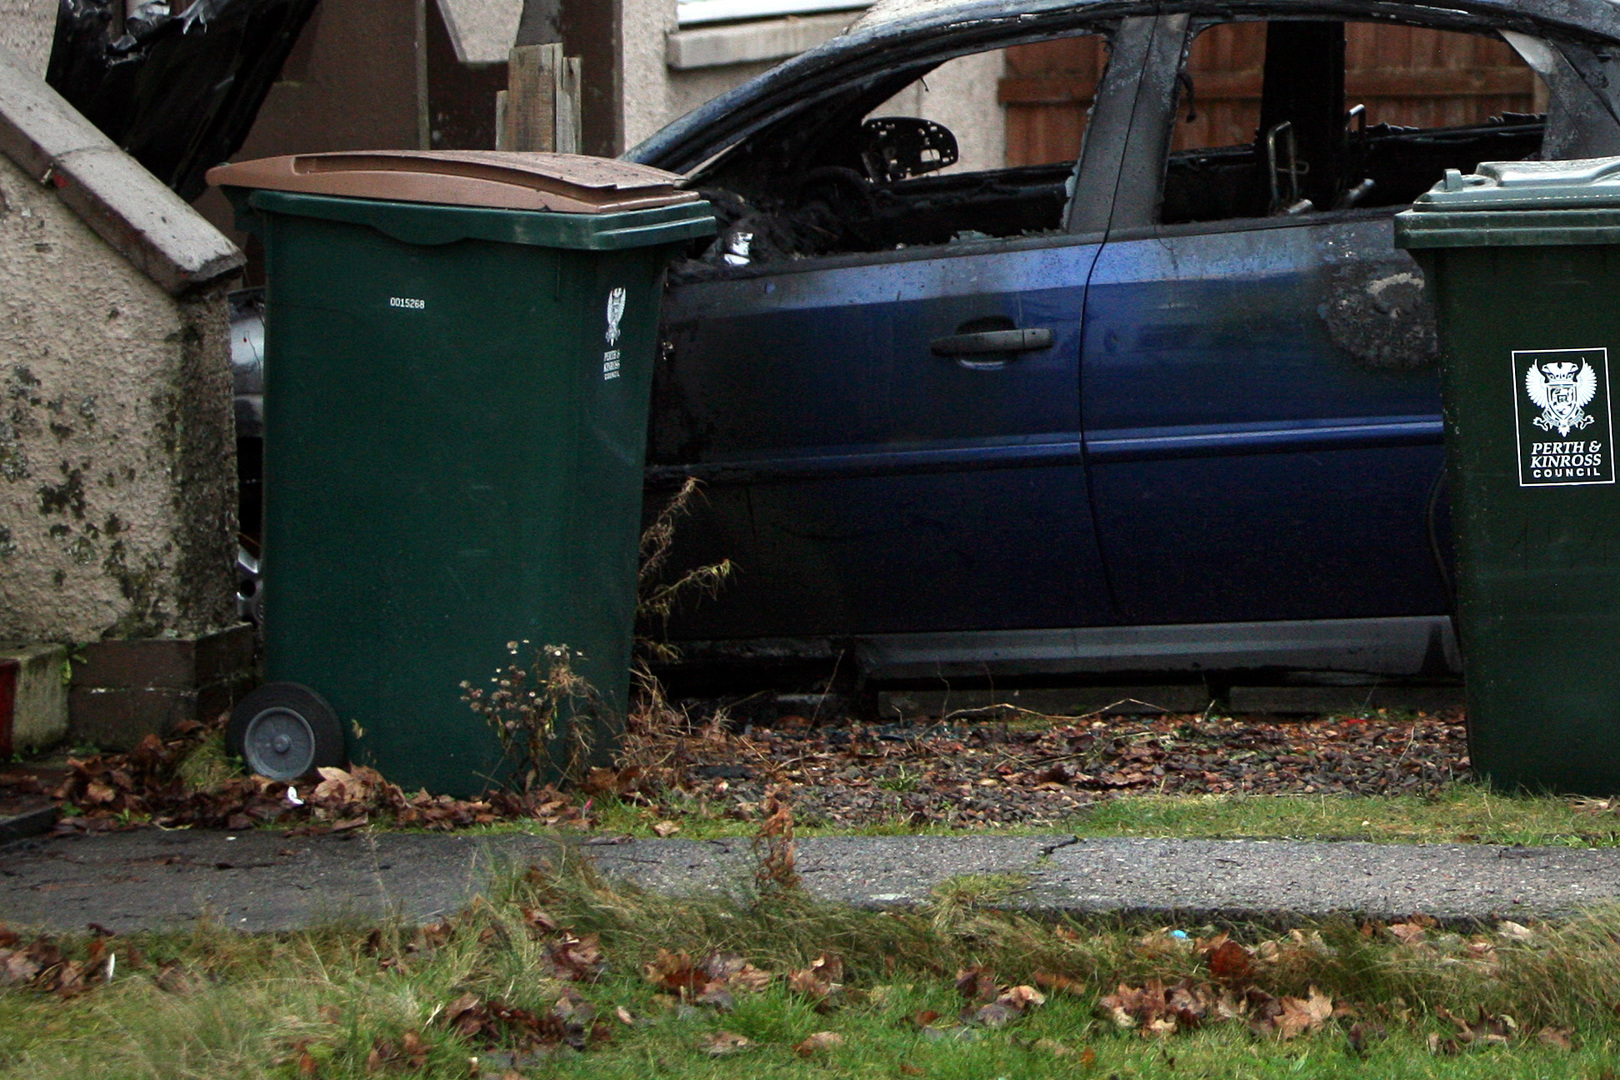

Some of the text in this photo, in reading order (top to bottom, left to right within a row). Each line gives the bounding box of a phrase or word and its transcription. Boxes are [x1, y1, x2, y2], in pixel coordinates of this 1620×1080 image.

[390, 297, 425, 309] 0015268
[1531, 440, 1602, 455] PERTH &
[1530, 454, 1602, 468] KINROSS
[1533, 468, 1600, 478] COUNCIL
